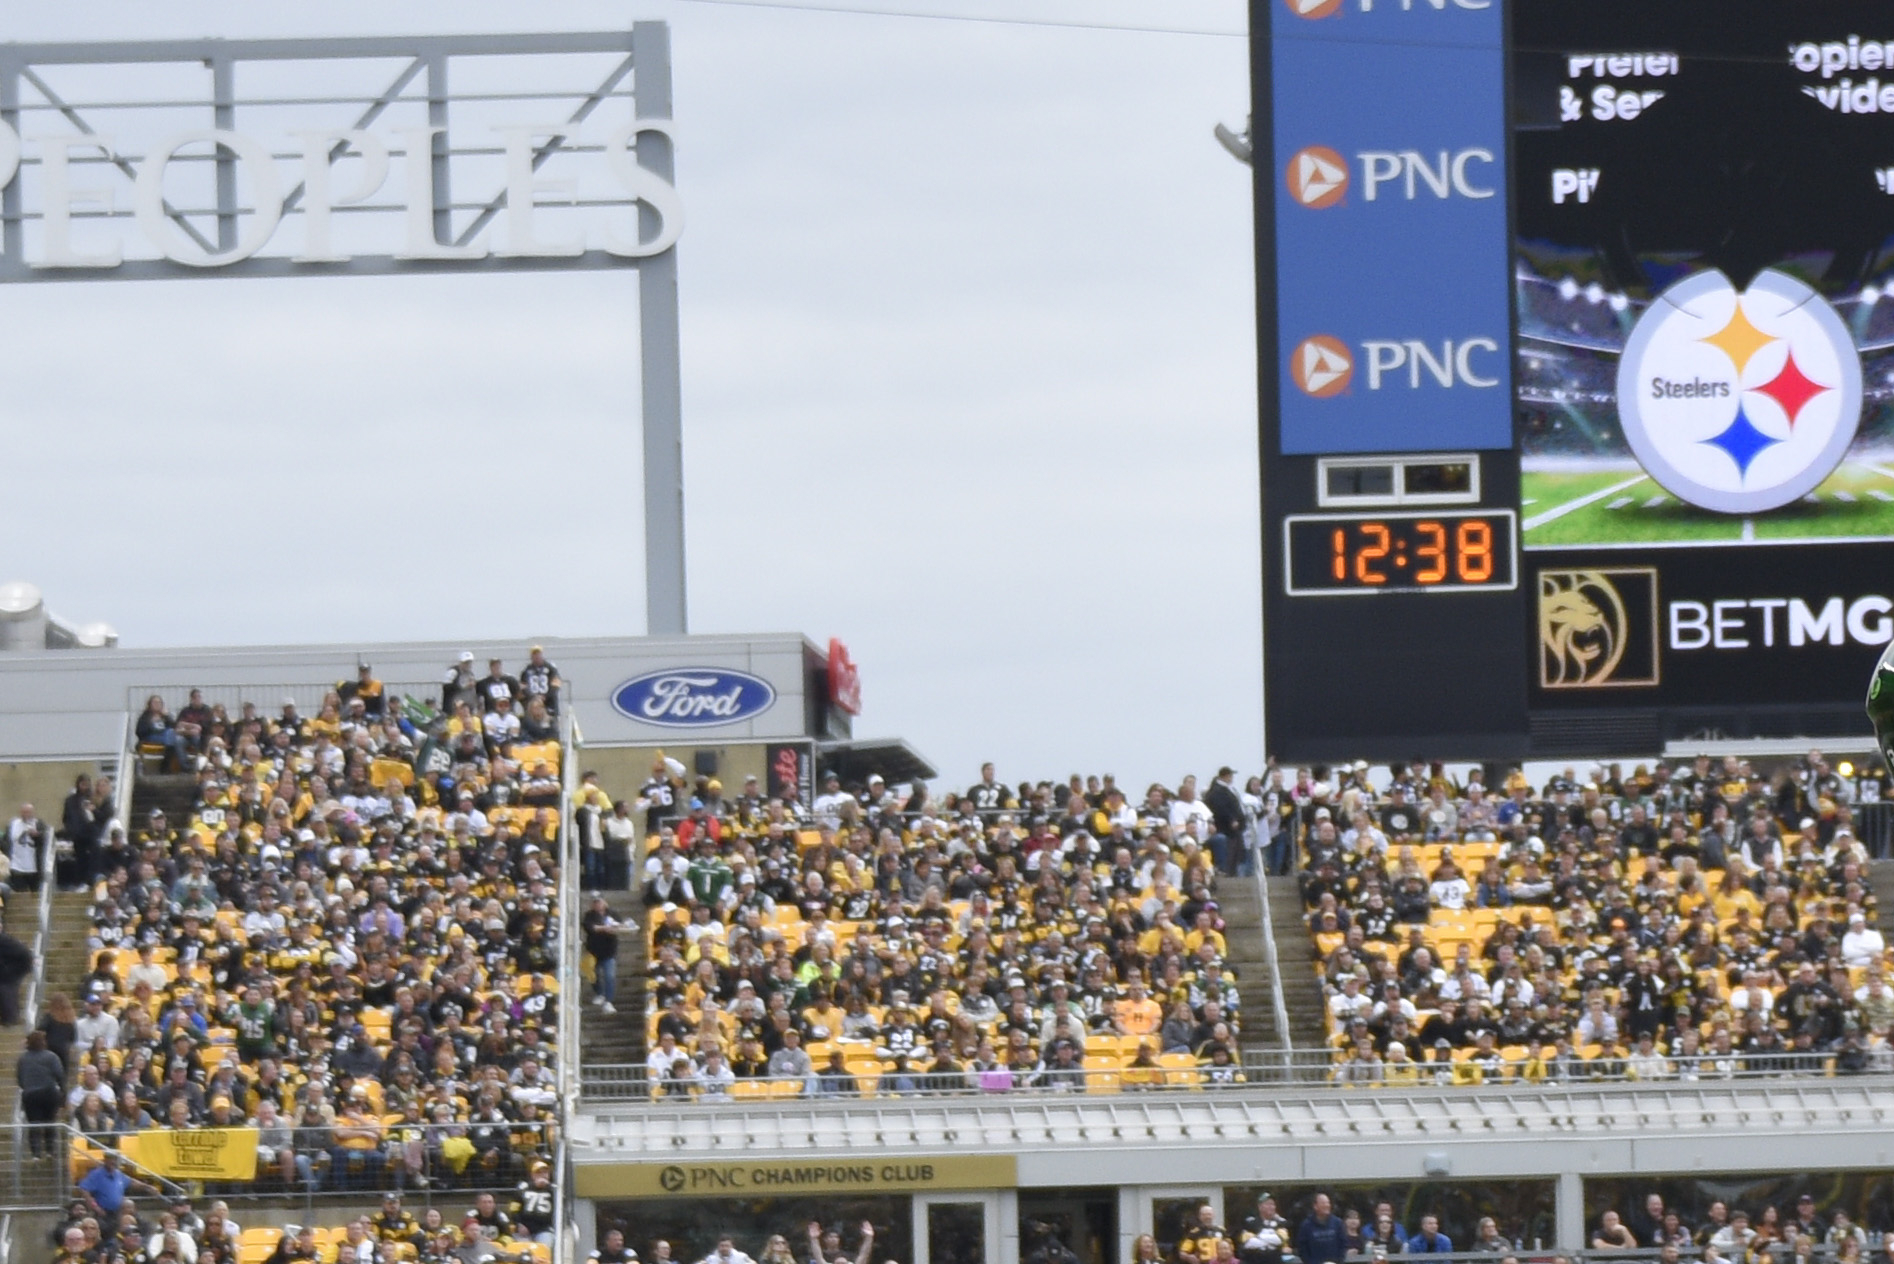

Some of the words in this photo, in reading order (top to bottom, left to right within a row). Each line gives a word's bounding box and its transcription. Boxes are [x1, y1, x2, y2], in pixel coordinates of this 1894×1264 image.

[1358, 147, 1496, 202] PNC
[1362, 337, 1500, 392] PNC
[1652, 376, 1730, 399] Steelers
[1332, 520, 1494, 584] 12:38
[643, 676, 744, 717] Ford
[692, 1168, 745, 1188] PNC
[752, 1166, 873, 1185] CHAMPIONS
[882, 1164, 934, 1182] CLUB
